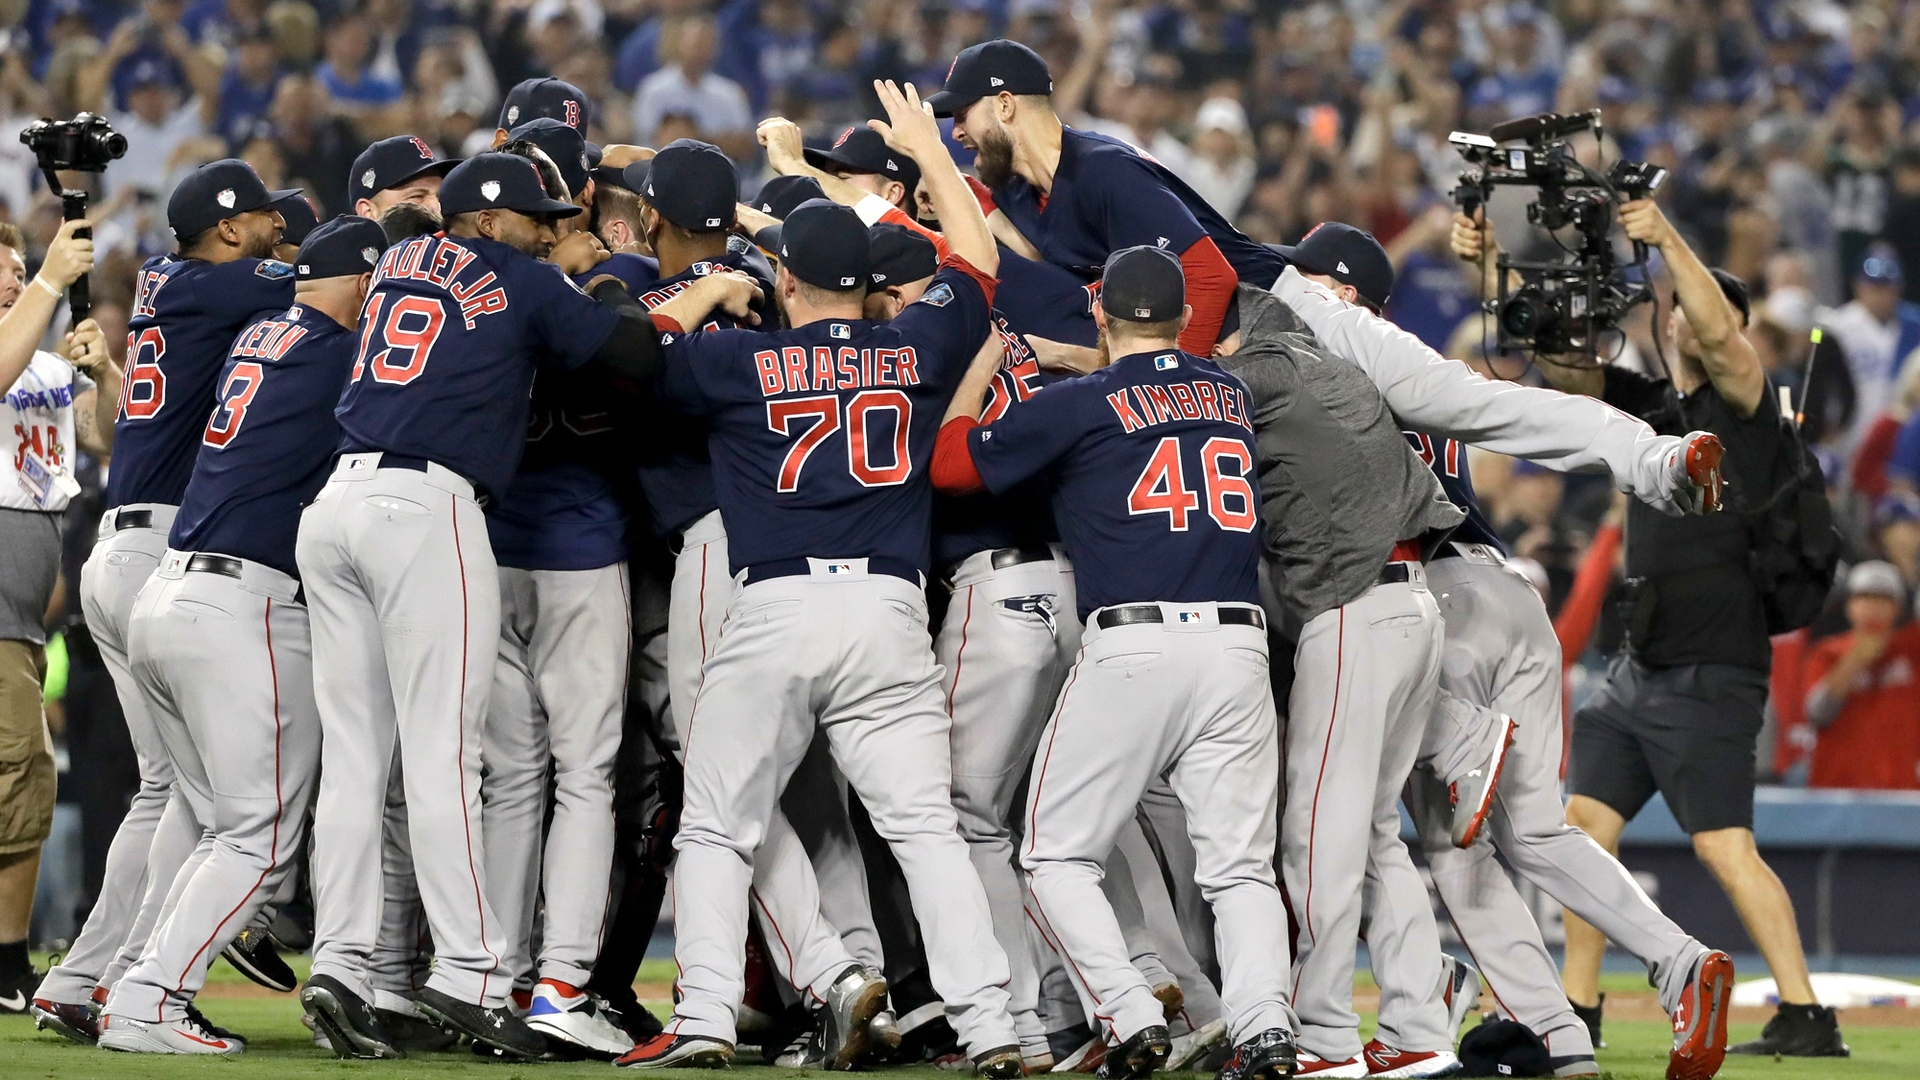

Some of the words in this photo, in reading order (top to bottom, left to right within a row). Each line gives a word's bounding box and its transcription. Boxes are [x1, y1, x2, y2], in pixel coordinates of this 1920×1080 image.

[562, 100, 581, 129] B
[231, 320, 309, 361] LEON
[351, 292, 447, 386] 19
[753, 345, 921, 397] BRASIER
[203, 361, 265, 449] 3
[1105, 380, 1254, 434] KIMBREL
[765, 389, 913, 493] 70
[1127, 436, 1258, 533] 46
